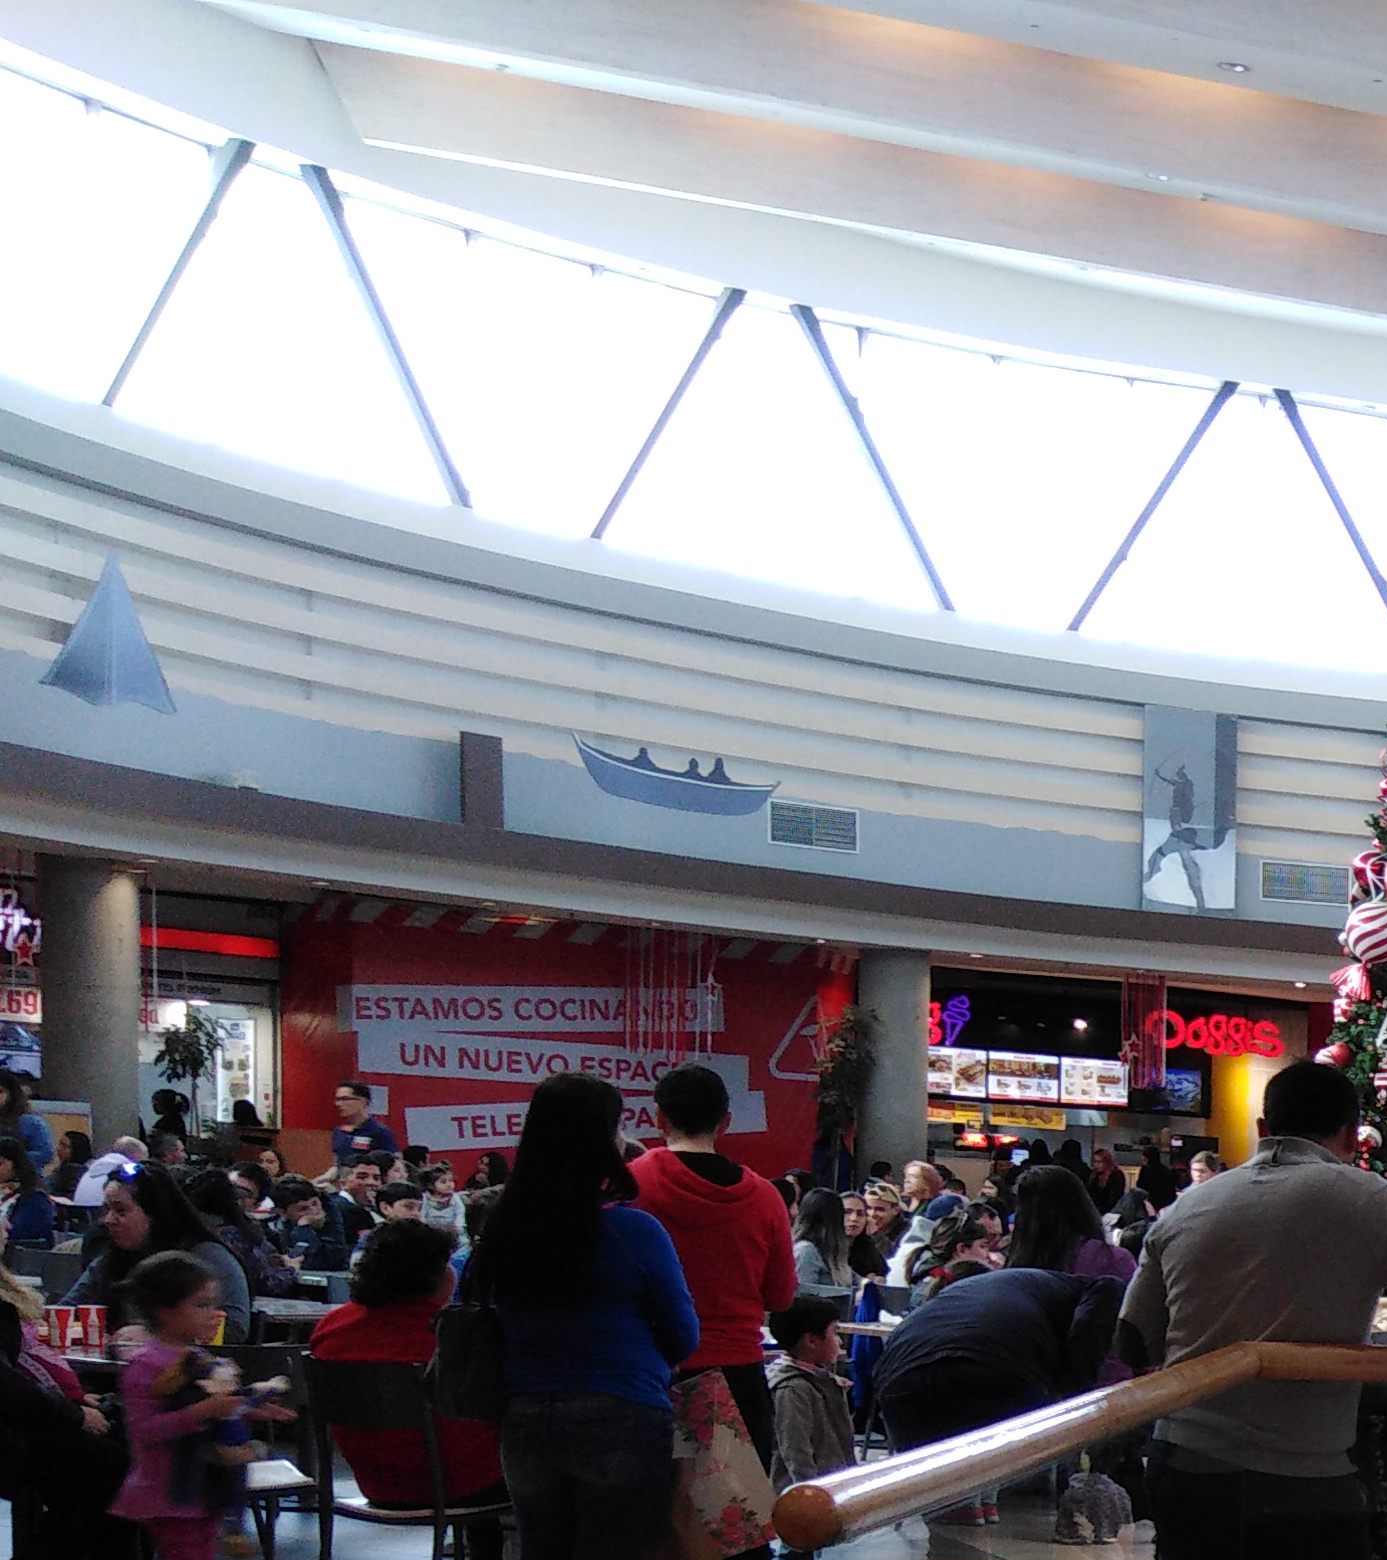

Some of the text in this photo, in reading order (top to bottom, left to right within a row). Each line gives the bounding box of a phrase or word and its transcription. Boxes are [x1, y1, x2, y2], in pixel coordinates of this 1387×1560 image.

[354, 996, 504, 1021] ESTAMOS
[1151, 1009, 1284, 1057] Doggis
[399, 1042, 447, 1069] UN
[457, 1046, 569, 1076] NUEVO
